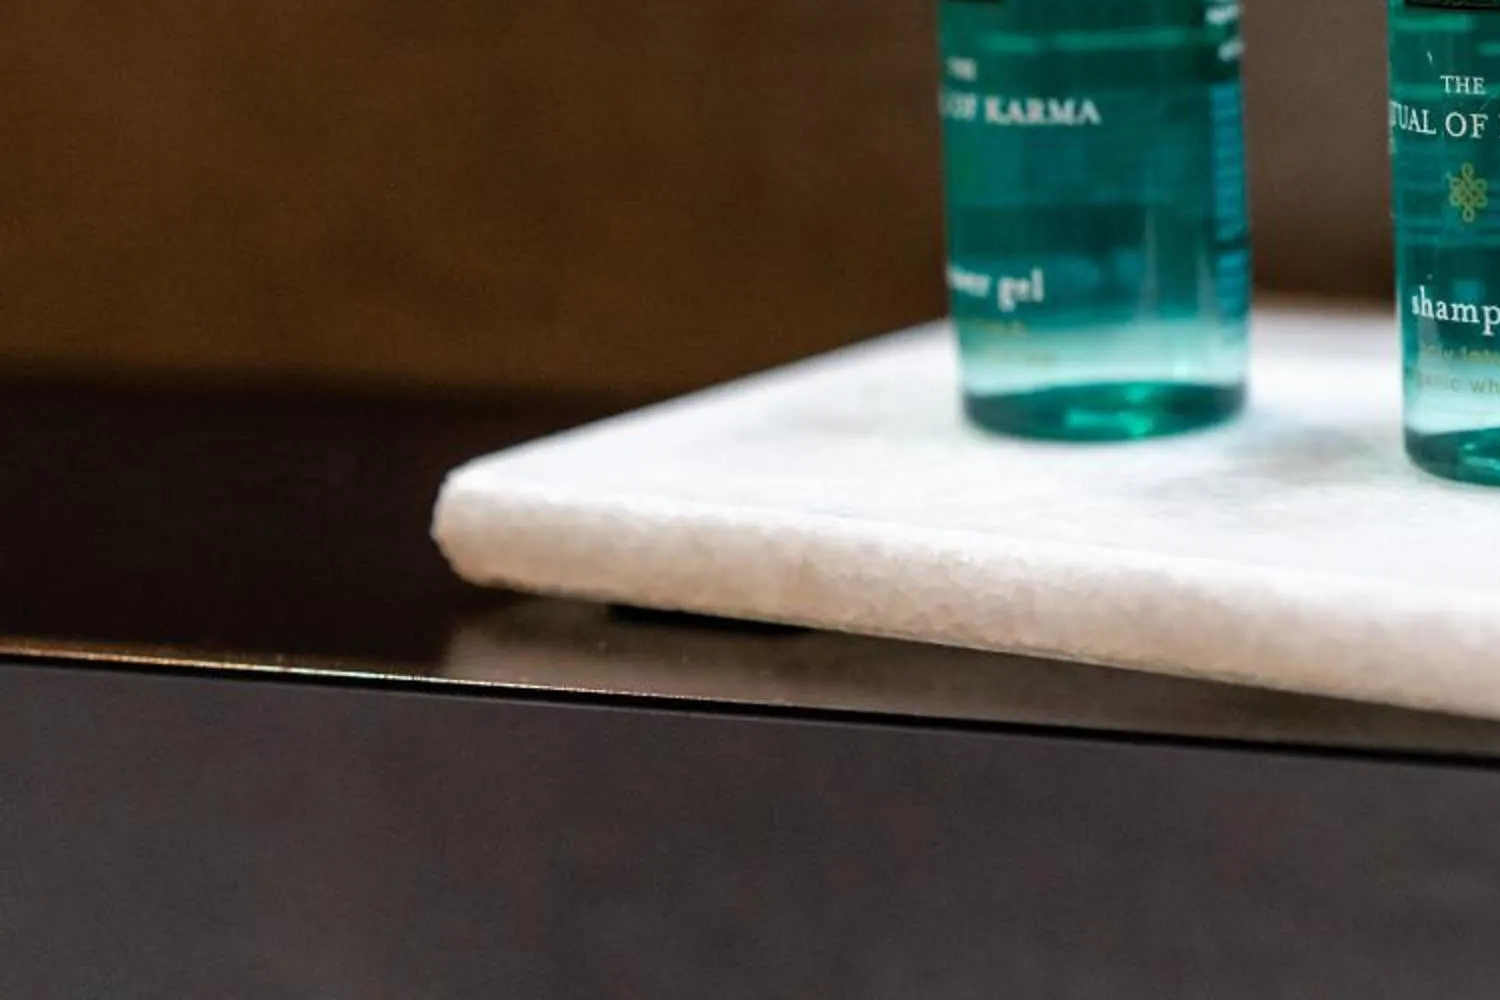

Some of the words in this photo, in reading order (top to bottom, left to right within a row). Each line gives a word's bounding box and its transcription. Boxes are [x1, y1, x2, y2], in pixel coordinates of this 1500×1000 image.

[1440, 75, 1486, 96] THE
[984, 96, 1102, 127] KARMA
[1444, 110, 1489, 139] OF
[997, 265, 1045, 313] gel
